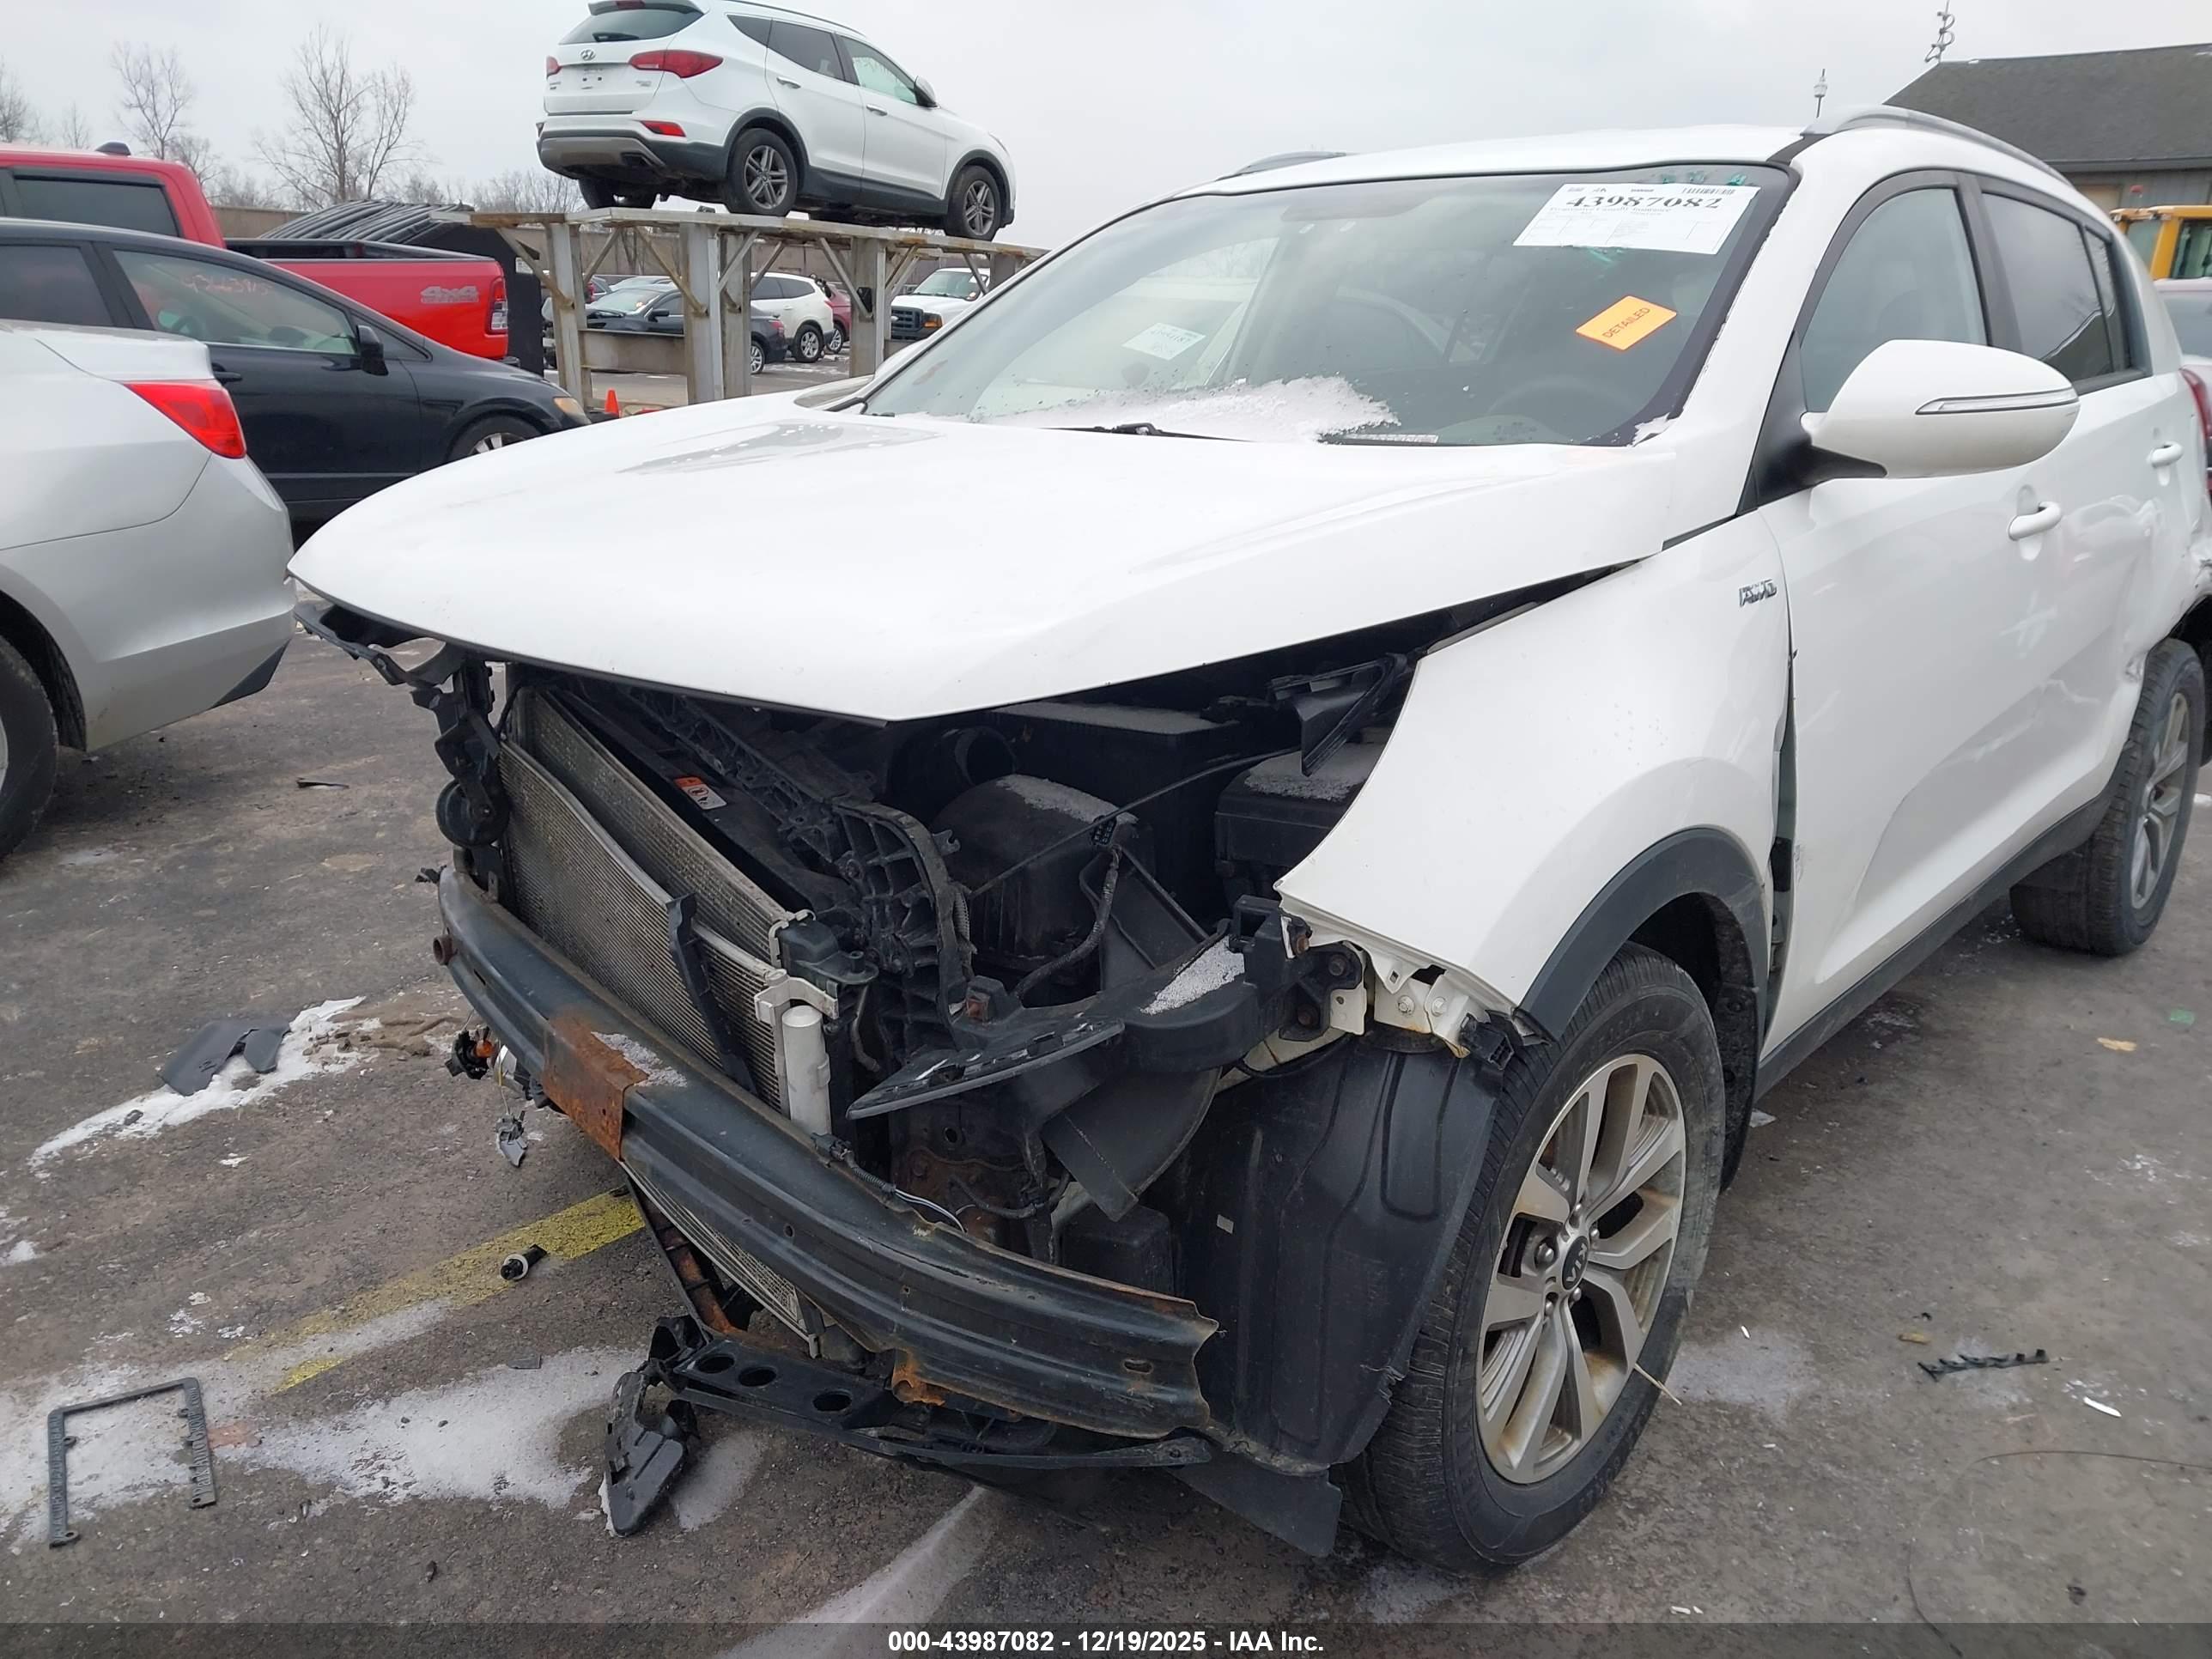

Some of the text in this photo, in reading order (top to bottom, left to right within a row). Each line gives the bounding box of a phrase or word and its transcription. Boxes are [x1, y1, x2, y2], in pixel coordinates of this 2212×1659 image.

[1566, 194, 1723, 210] 43987082
[1601, 307, 1650, 338] DETAILED
[1739, 579, 1778, 607] AWD
[1565, 1243, 1588, 1282] KIA
